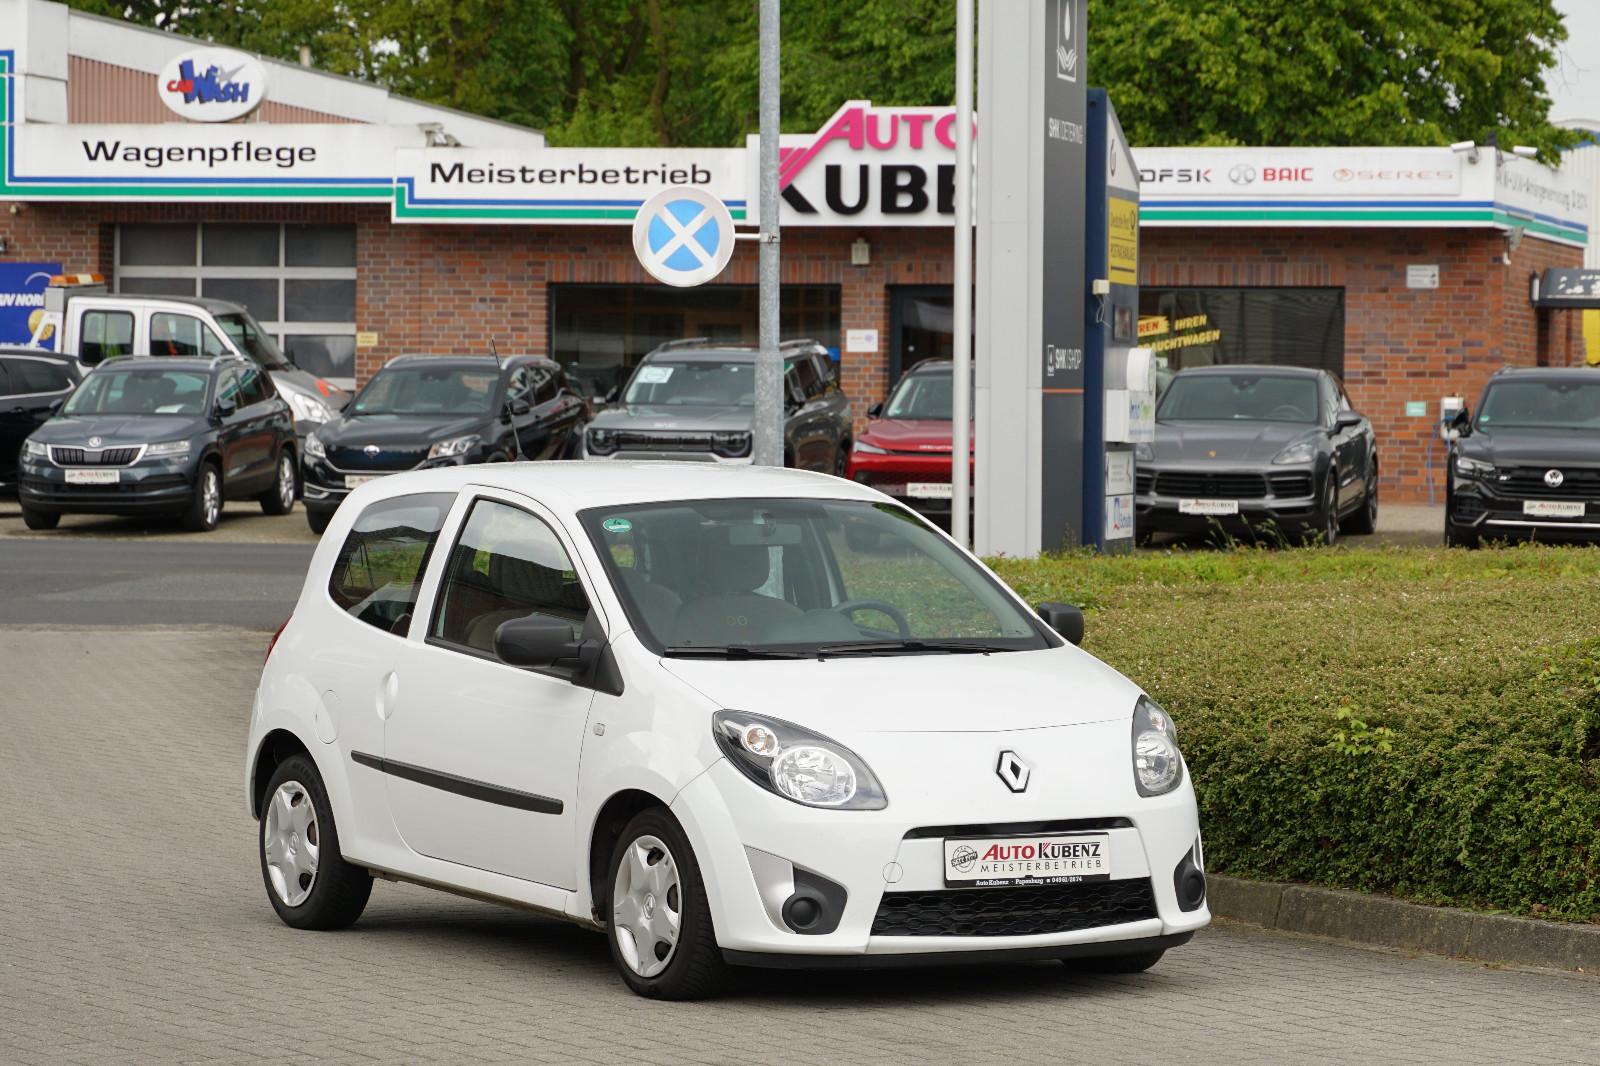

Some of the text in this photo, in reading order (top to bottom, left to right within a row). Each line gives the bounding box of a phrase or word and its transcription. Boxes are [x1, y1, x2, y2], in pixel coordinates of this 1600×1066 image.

[82, 141, 317, 168] Wagenpflege
[430, 163, 711, 185] Meisterbetrieb
[1263, 167, 1314, 182] BAIC
[1175, 315, 1207, 330] IHREN
[1138, 330, 1220, 352] AUCHTWAGEN
[981, 844, 1035, 861] AUTO
[1038, 842, 1101, 859] KUBENZ
[980, 860, 1102, 873] MEISTERBETRIEB
